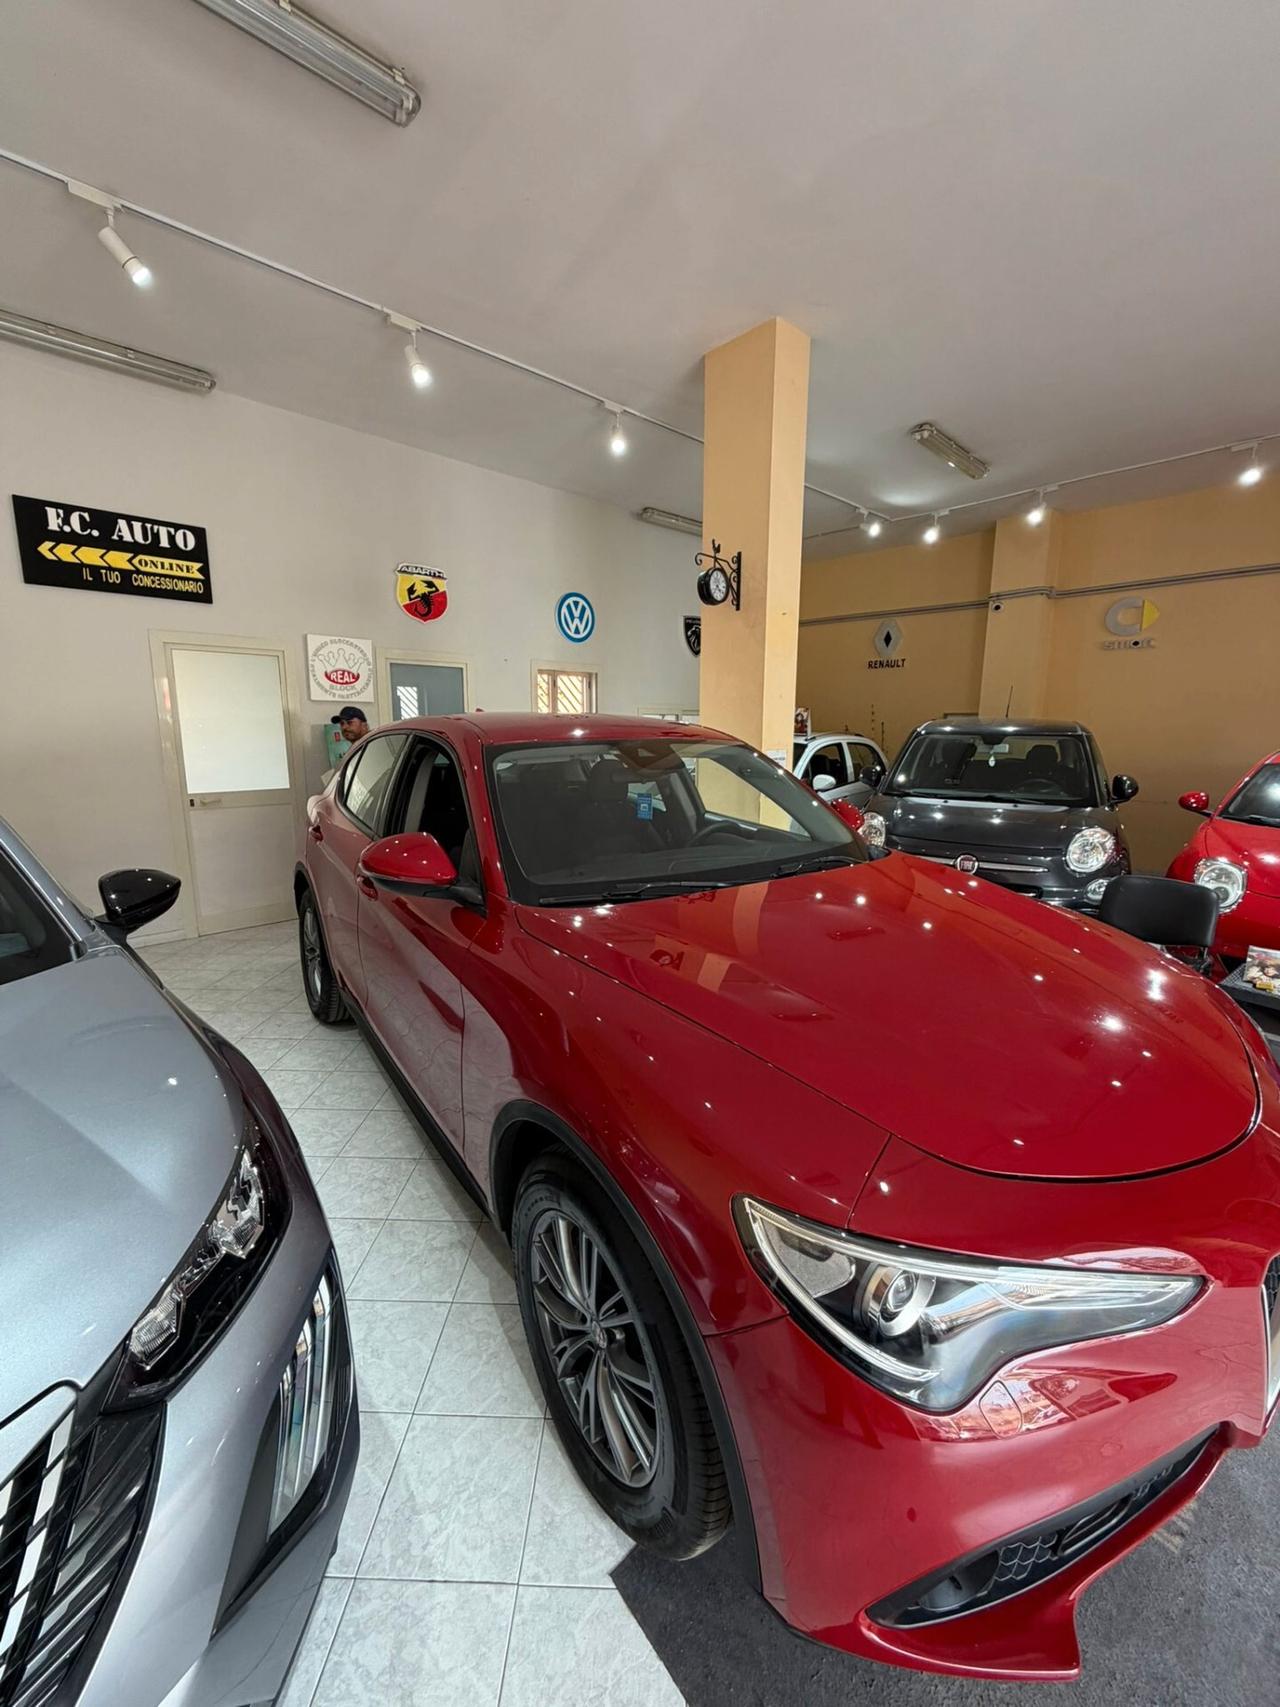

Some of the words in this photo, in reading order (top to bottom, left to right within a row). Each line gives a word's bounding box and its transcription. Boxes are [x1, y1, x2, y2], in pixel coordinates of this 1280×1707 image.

[44, 506, 100, 537] F.C.
[111, 518, 196, 552] AUTO
[137, 558, 196, 575] ONLINE
[399, 565, 444, 577] ABARTH
[82, 567, 94, 581] IL
[100, 569, 121, 584] TUO
[132, 573, 204, 594] CONCESSIONARIO
[867, 658, 906, 669] RENAULT
[330, 670, 357, 684] REAL
